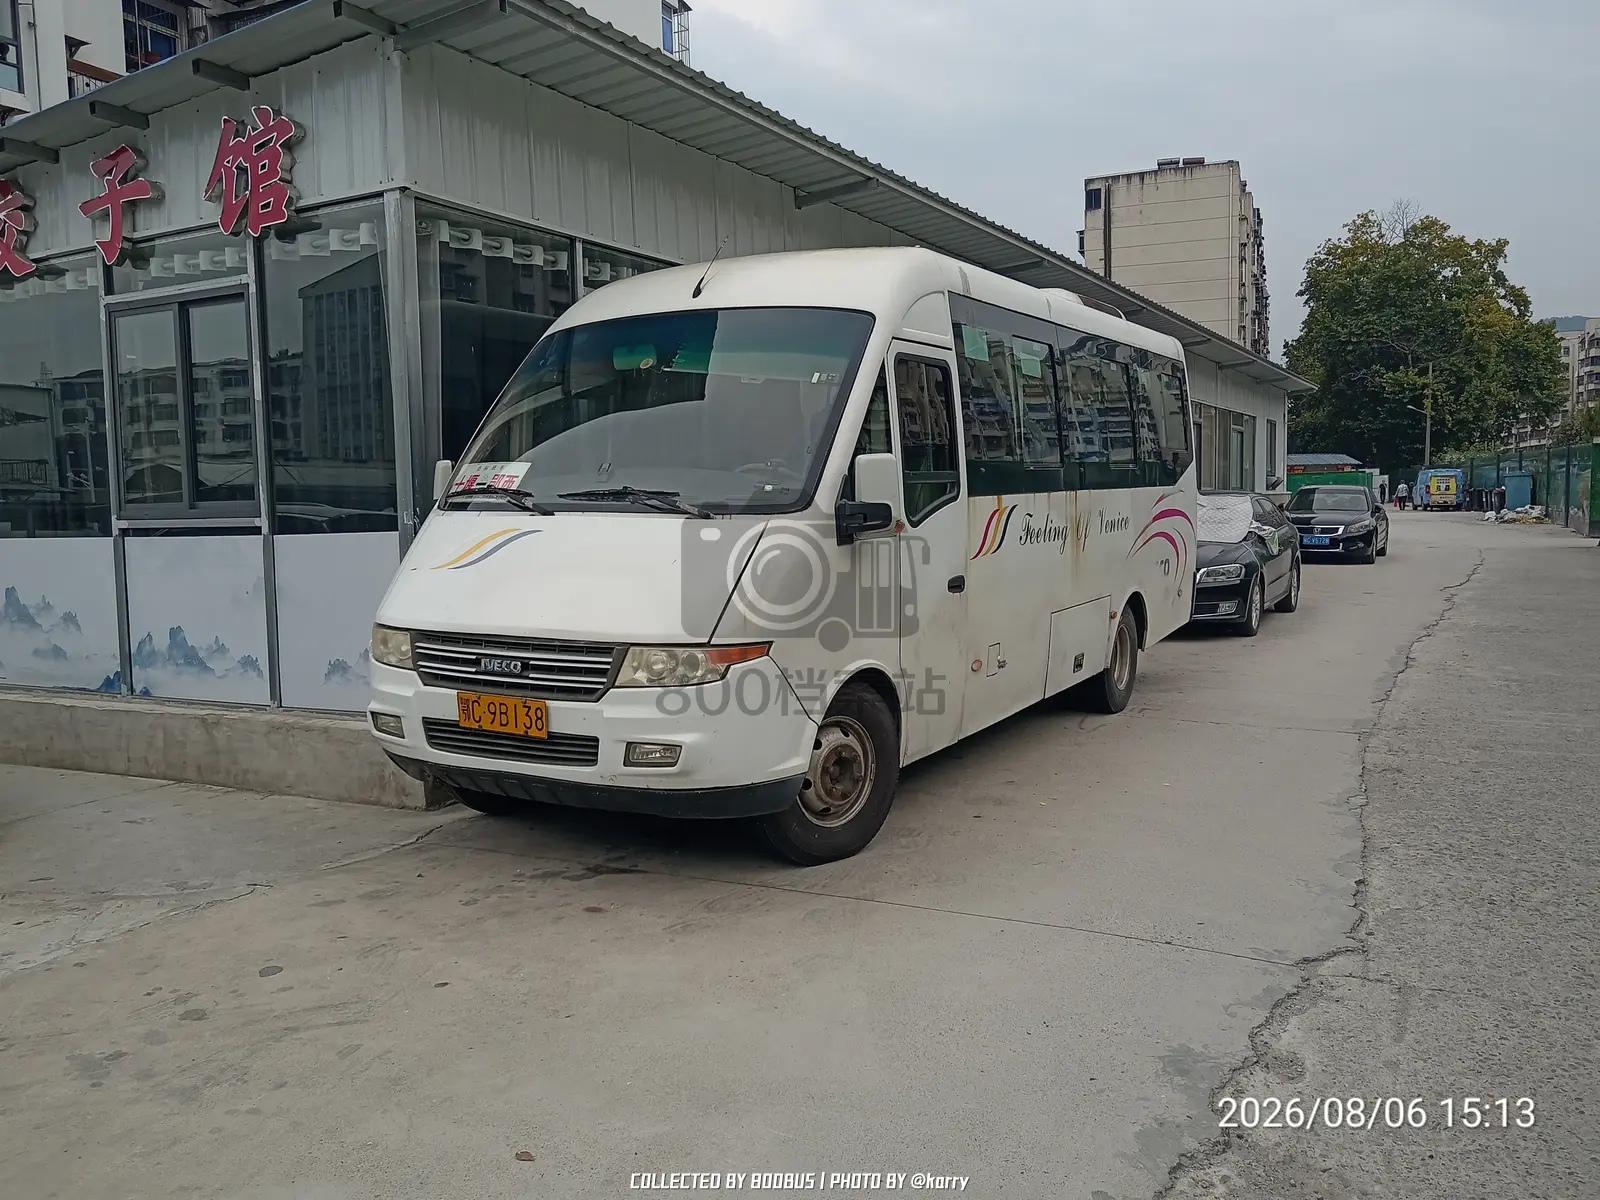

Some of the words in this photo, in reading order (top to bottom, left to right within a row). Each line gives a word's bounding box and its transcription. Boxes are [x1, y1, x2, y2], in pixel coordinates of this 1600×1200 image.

[1019, 513, 1069, 555] Feeling
[1076, 510, 1092, 552] Of
[1098, 506, 1130, 535] Venice
[480, 658, 522, 674] IVECO
